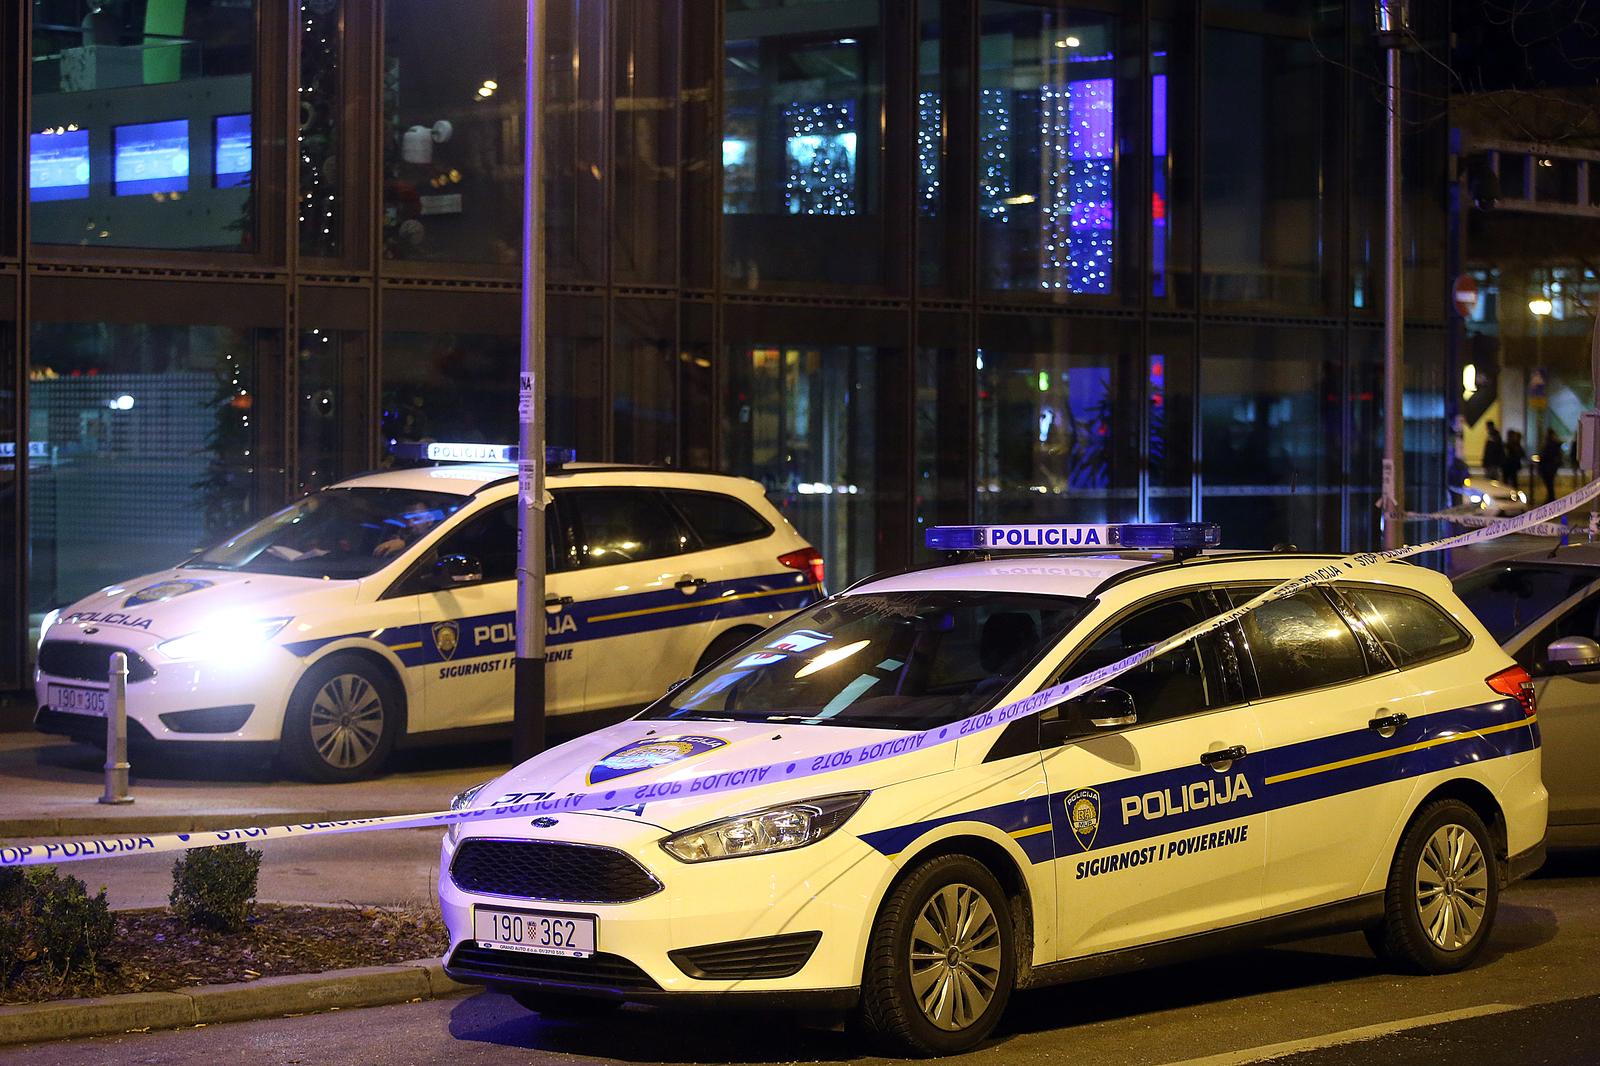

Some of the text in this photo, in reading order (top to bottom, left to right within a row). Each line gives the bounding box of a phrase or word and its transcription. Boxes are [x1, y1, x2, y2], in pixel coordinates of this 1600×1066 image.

[433, 446, 497, 459] POLICIJA
[991, 528, 1101, 546] POLICIJA
[65, 611, 153, 630] POLICIJA
[439, 659, 502, 679] SIGURNOST
[503, 659, 508, 670] I
[57, 688, 105, 712] 190 305
[1066, 790, 1098, 806] POLICIJA
[1121, 773, 1253, 825] POLICIJA
[1075, 825, 1248, 880] SIGURNOST I POVJERENJE
[493, 914, 576, 948] 190 362
